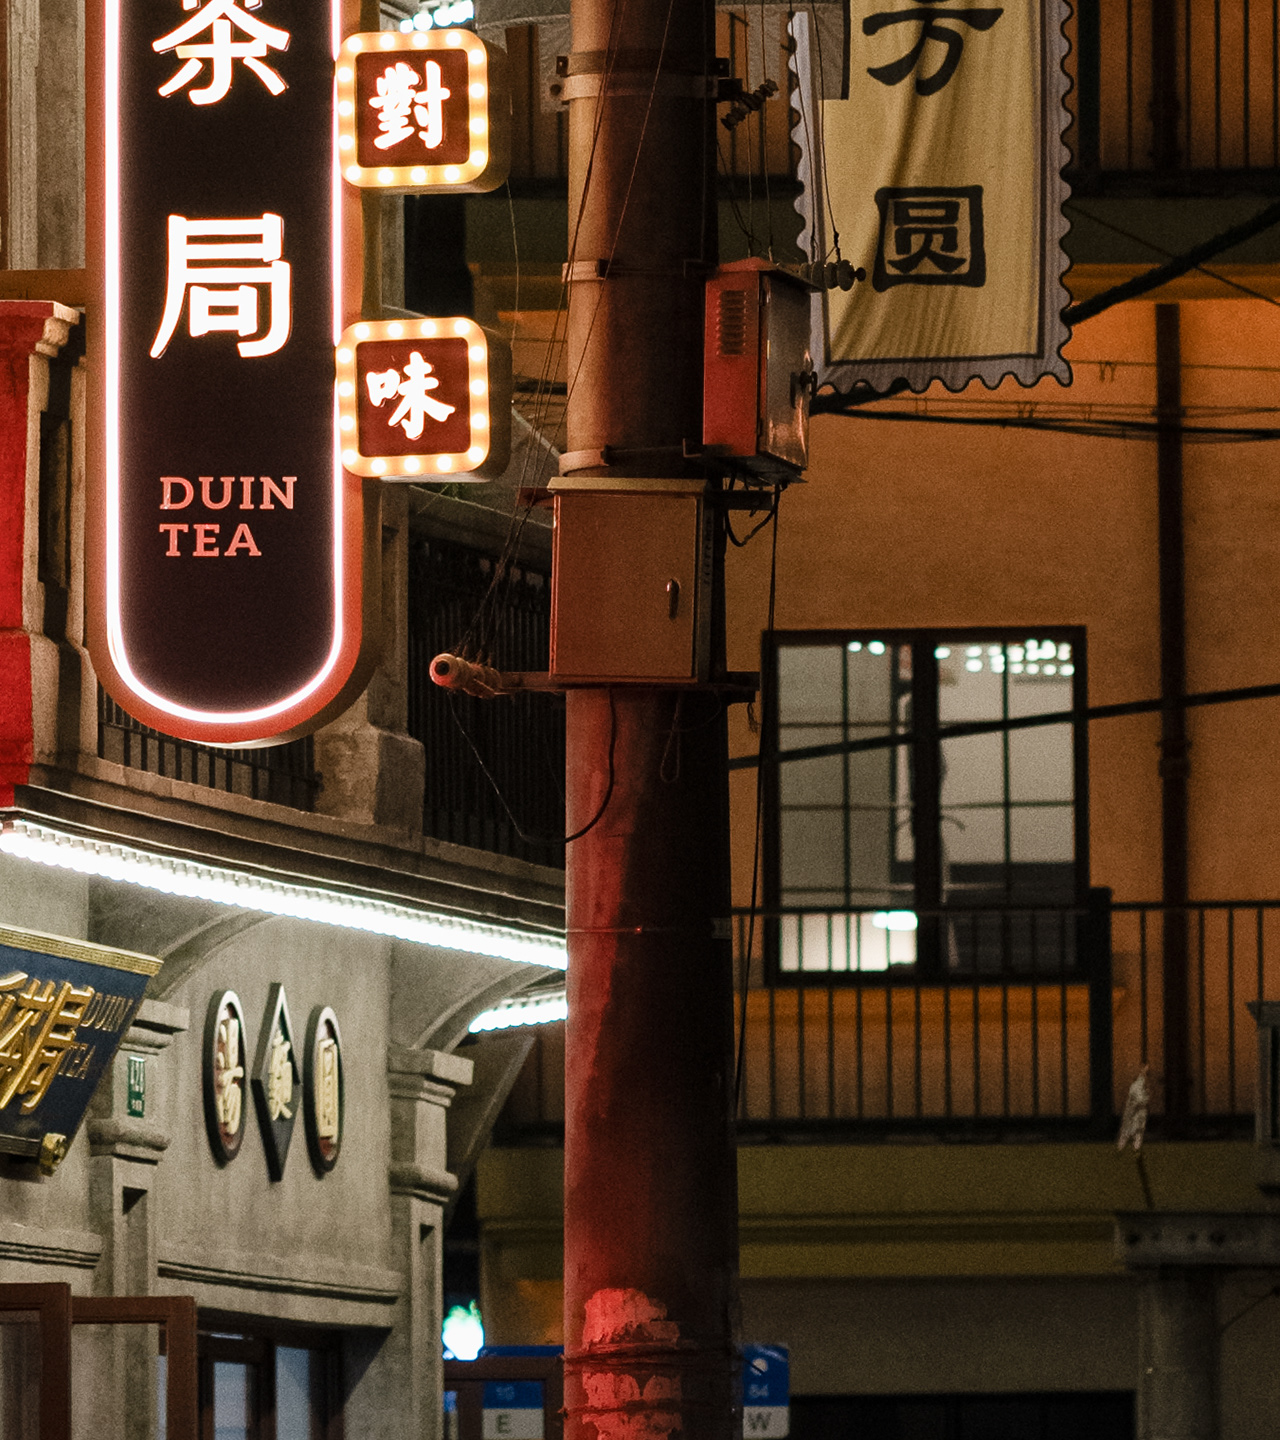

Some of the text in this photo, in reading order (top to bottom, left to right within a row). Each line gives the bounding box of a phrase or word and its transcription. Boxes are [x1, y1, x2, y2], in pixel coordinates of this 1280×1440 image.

[159, 476, 298, 511] DUIN
[159, 522, 264, 558] TEA
[81, 992, 134, 1033] DUIN
[56, 1042, 97, 1081] TEA
[497, 1413, 512, 1434] E
[747, 1411, 772, 1431] W
